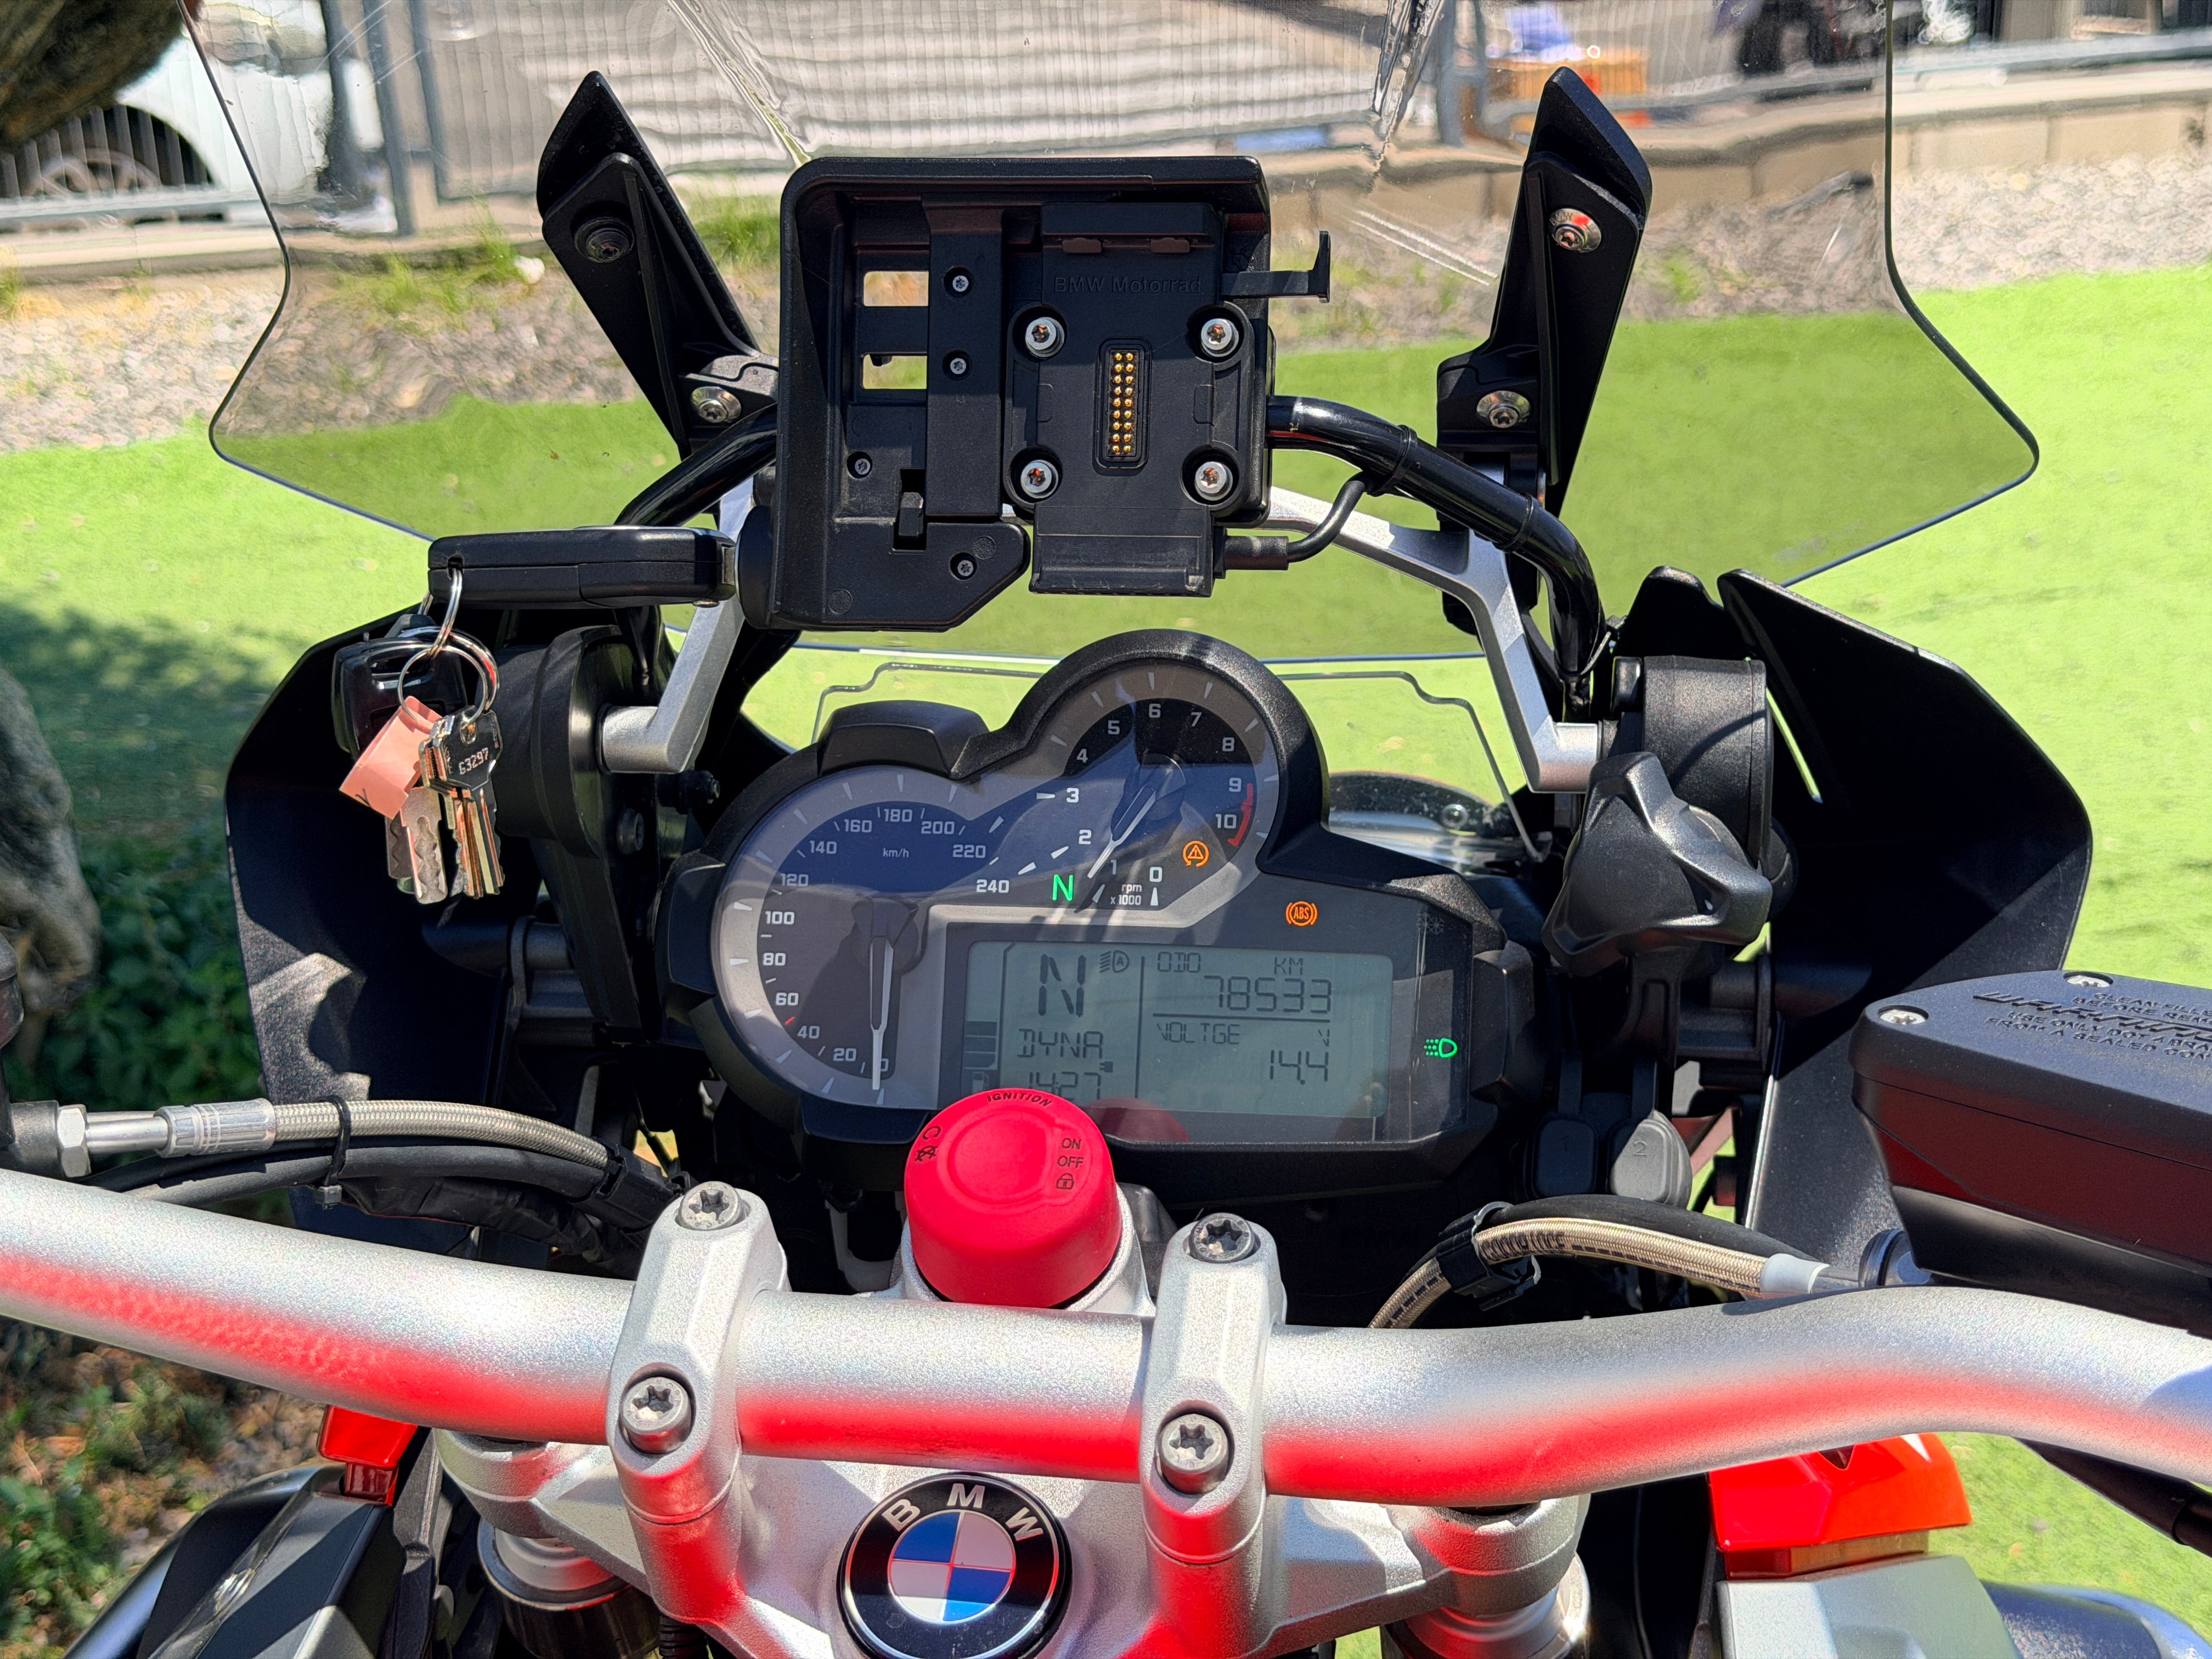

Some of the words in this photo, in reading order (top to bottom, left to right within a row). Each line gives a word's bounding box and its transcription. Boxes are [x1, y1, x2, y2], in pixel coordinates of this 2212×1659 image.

[1054, 276, 1103, 293] BMW
[1112, 276, 1202, 293] Motorrad
[1149, 704, 1161, 719] 6
[1191, 712, 1202, 727] 7
[1108, 721, 1120, 735] 5
[1222, 737, 1235, 752] 8
[1076, 749, 1088, 763] 4
[1229, 778, 1242, 792] 9
[1066, 788, 1080, 803] 3
[884, 809, 913, 822] 180
[1216, 814, 1237, 829] 10
[844, 820, 872, 833] 160
[921, 821, 955, 834] 200
[1079, 830, 1092, 844] 2
[809, 841, 837, 854] 140
[883, 848, 909, 858] km/h
[953, 845, 986, 859] 220
[1111, 860, 1117, 875] 1
[1149, 867, 1163, 882] 0
[781, 874, 809, 887] 120
[976, 880, 1009, 894] 240
[1052, 874, 1074, 901] N
[1122, 884, 1142, 894] rpm
[1119, 894, 1142, 905] 1000
[765, 911, 795, 926] 100
[1294, 906, 1310, 920] ABS
[763, 953, 786, 967] 80
[1158, 952, 1200, 973] ODO
[1274, 956, 1304, 975] KM
[1039, 953, 1086, 1017] N
[775, 993, 798, 1007] 60
[1204, 975, 1332, 1013] 78533
[2094, 992, 2158, 1007] CLEAN
[2072, 996, 2157, 1015] BEFORE
[798, 1026, 820, 1039] 40
[1156, 1022, 1241, 1045] VOLTGE
[1318, 1029, 1330, 1047] V
[1984, 1017, 2046, 1032] FROM
[2073, 1032, 2157, 1052] SEALED
[2008, 1011, 2048, 1024] USE
[2050, 1019, 2104, 1032] ONLY
[2107, 1028, 2150, 1039] DOT
[2168, 1038, 2212, 1051] BRA
[1017, 1028, 1103, 1059] DYNA
[833, 1048, 856, 1062] 20
[1269, 1049, 1329, 1085] 14.4
[988, 1092, 1053, 1107] IGNITION
[1061, 1137, 1082, 1149] ON
[1633, 1141, 1647, 1156] 2
[1057, 1155, 1085, 1168] OFF
[882, 1483, 1043, 1541] BMW
